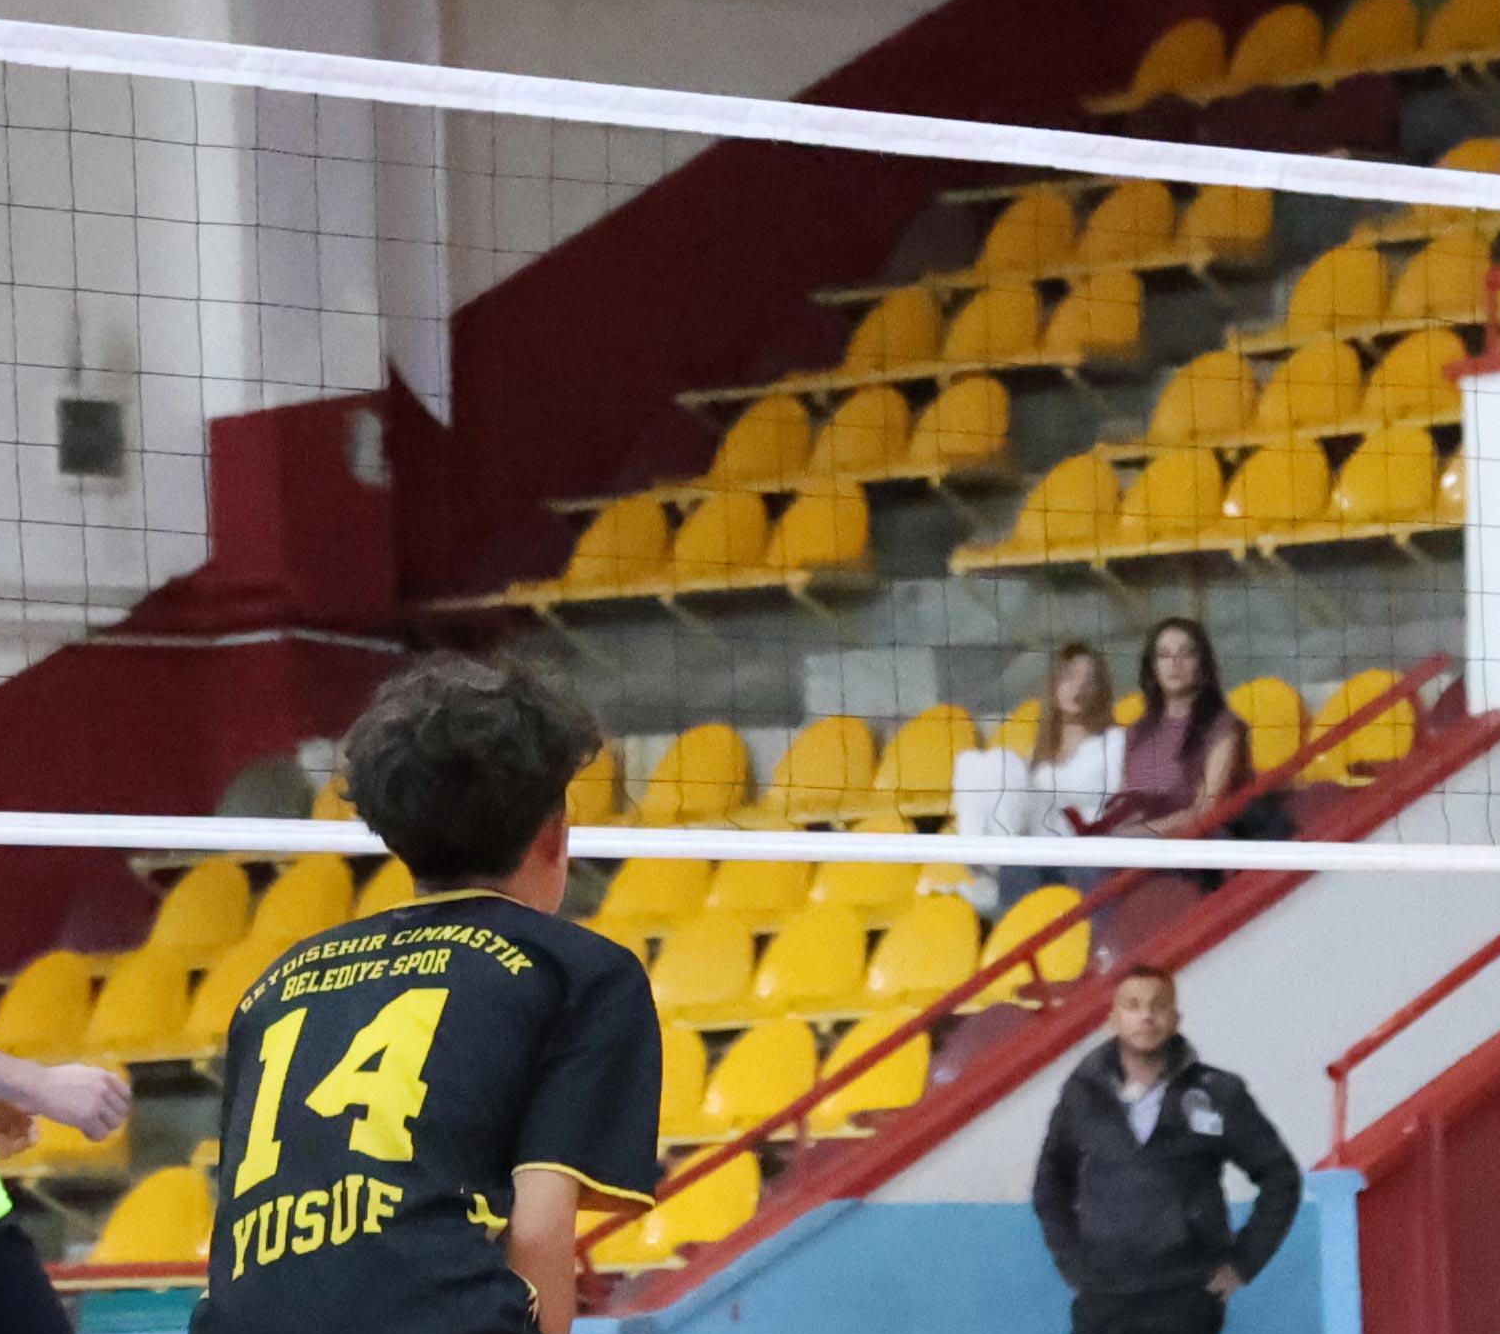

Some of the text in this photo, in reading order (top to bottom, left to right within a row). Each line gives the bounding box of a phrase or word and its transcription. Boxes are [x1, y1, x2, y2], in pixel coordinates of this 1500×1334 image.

[389, 948, 452, 976] SPOR
[234, 988, 450, 1200] 14
[232, 1173, 405, 1282] YUSUF
